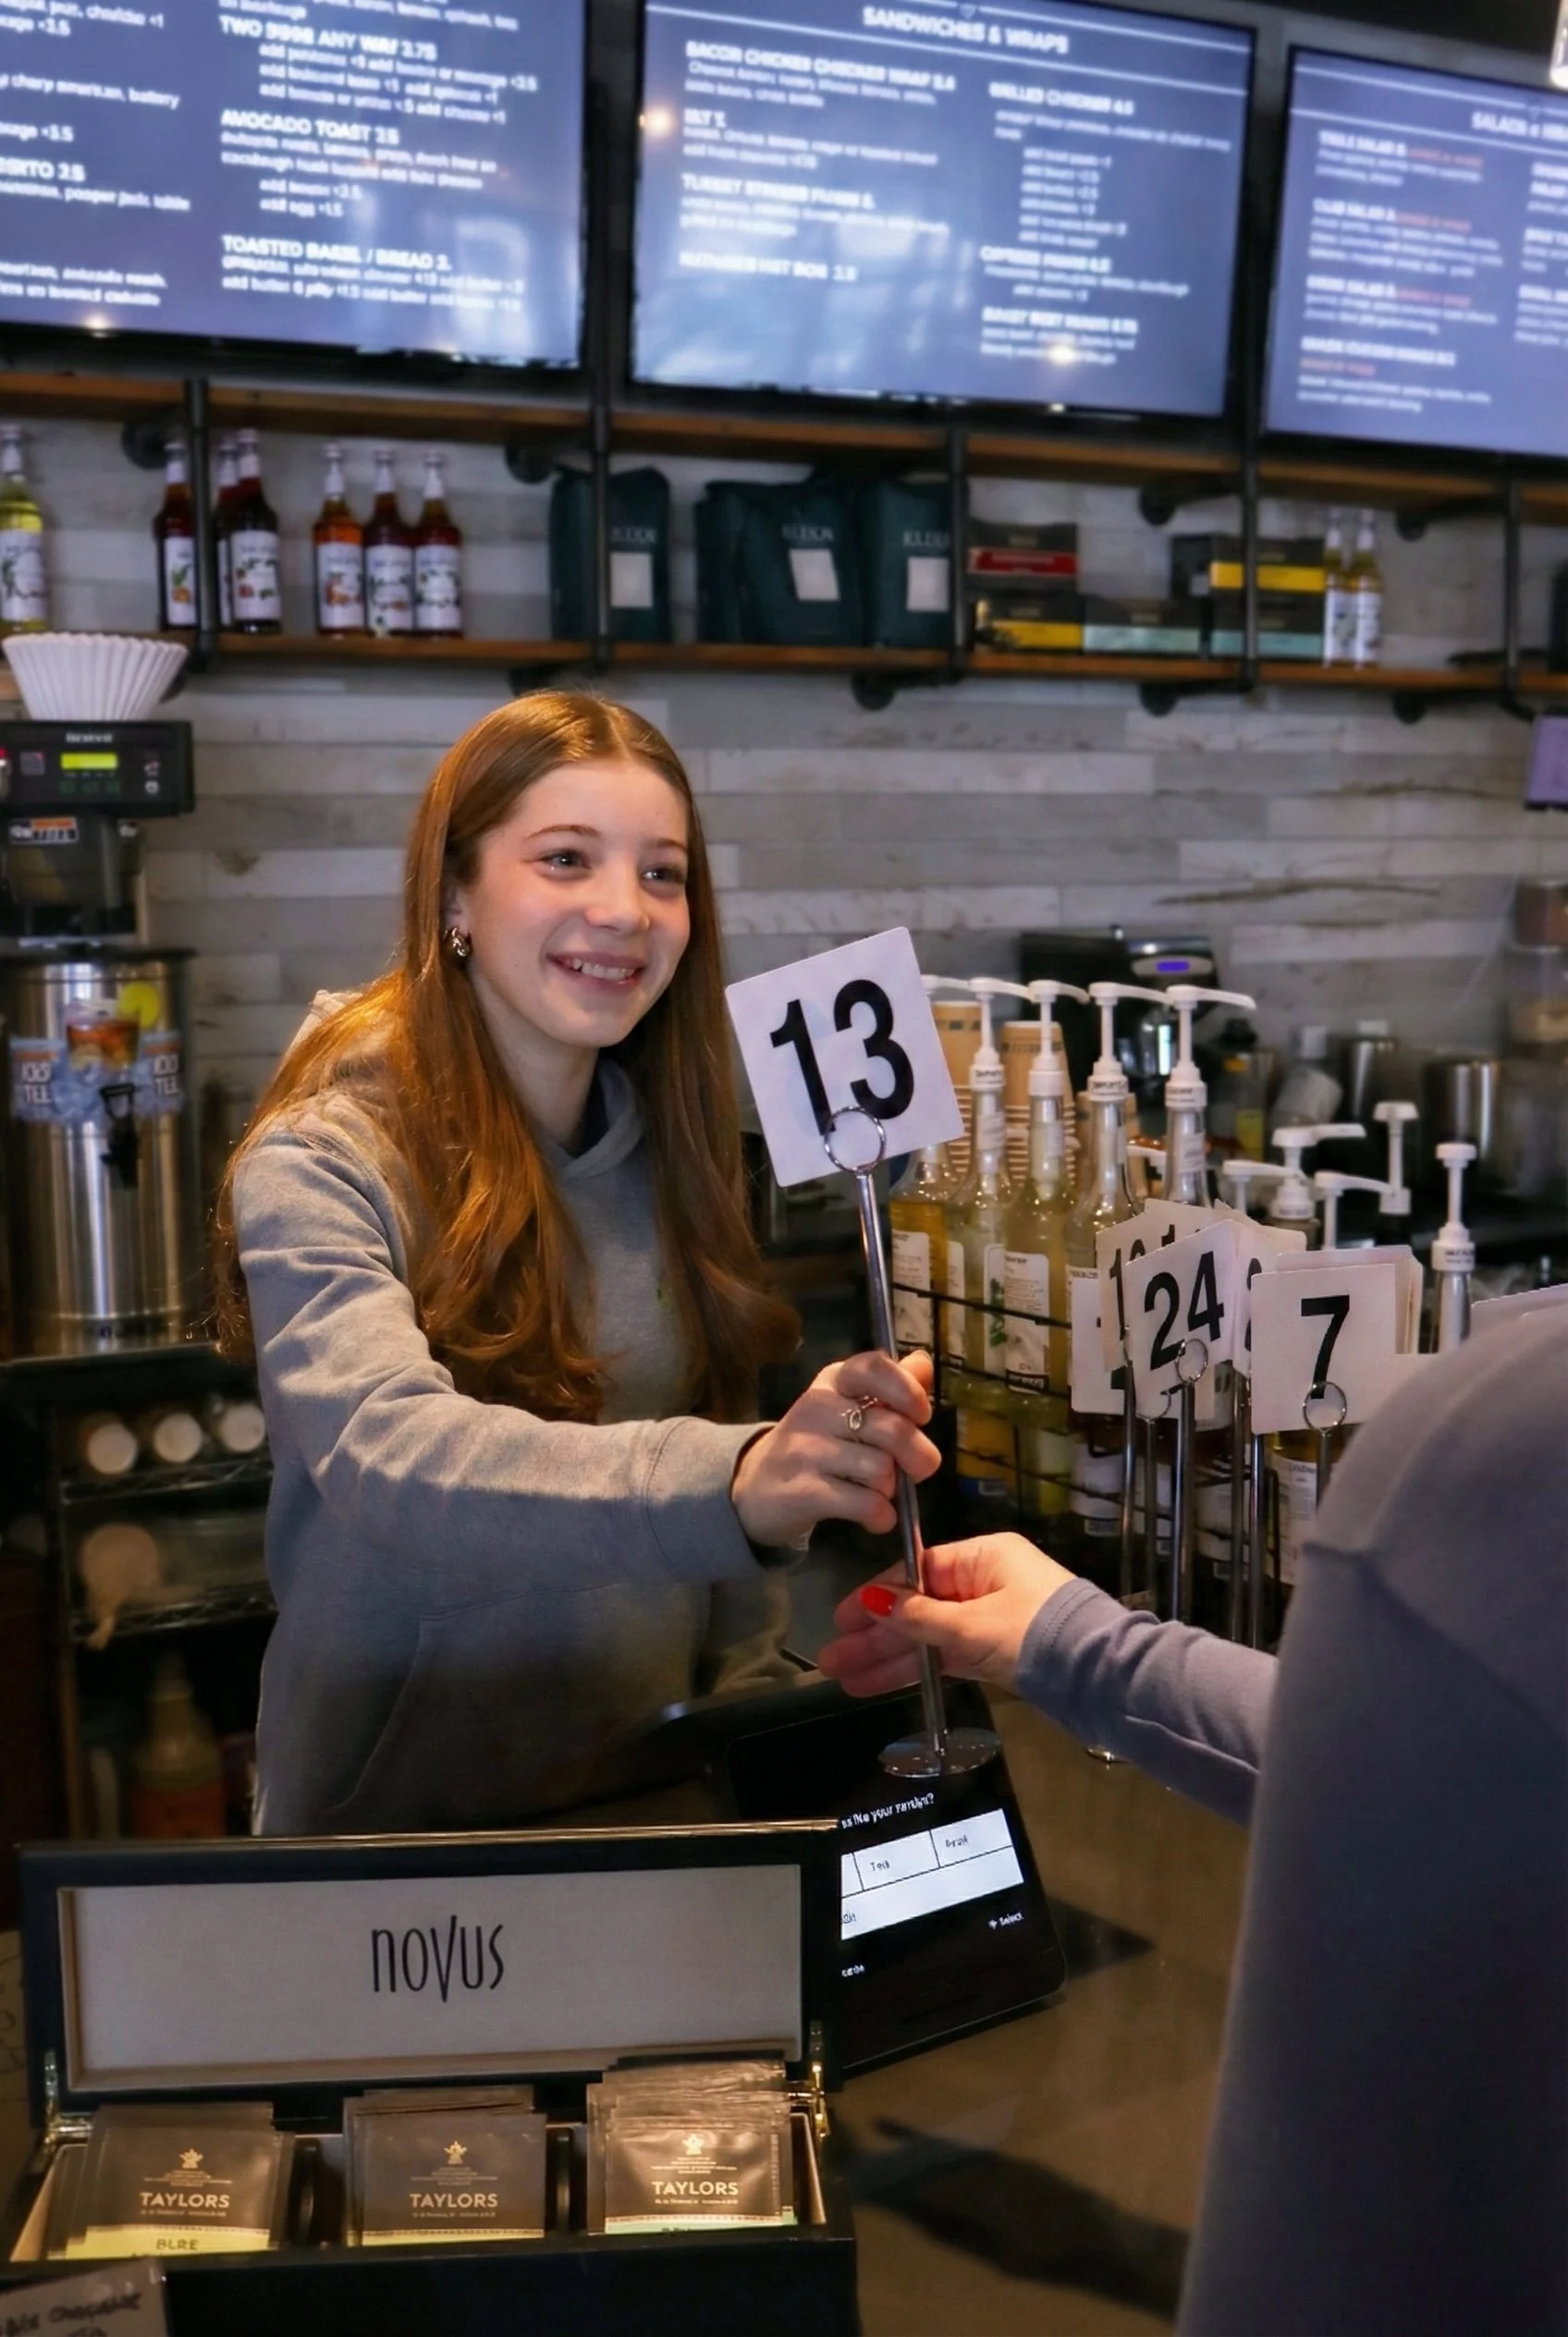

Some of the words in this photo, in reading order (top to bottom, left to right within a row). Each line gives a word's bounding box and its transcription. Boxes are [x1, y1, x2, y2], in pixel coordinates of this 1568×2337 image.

[769, 978, 913, 1136] 13
[1145, 1250, 1225, 1371] 24
[1301, 1294, 1351, 1399] 7
[140, 2190, 230, 2209] TAYLORS
[410, 2192, 498, 2209] TAYLORS
[651, 2180, 740, 2196] TAYLORS
